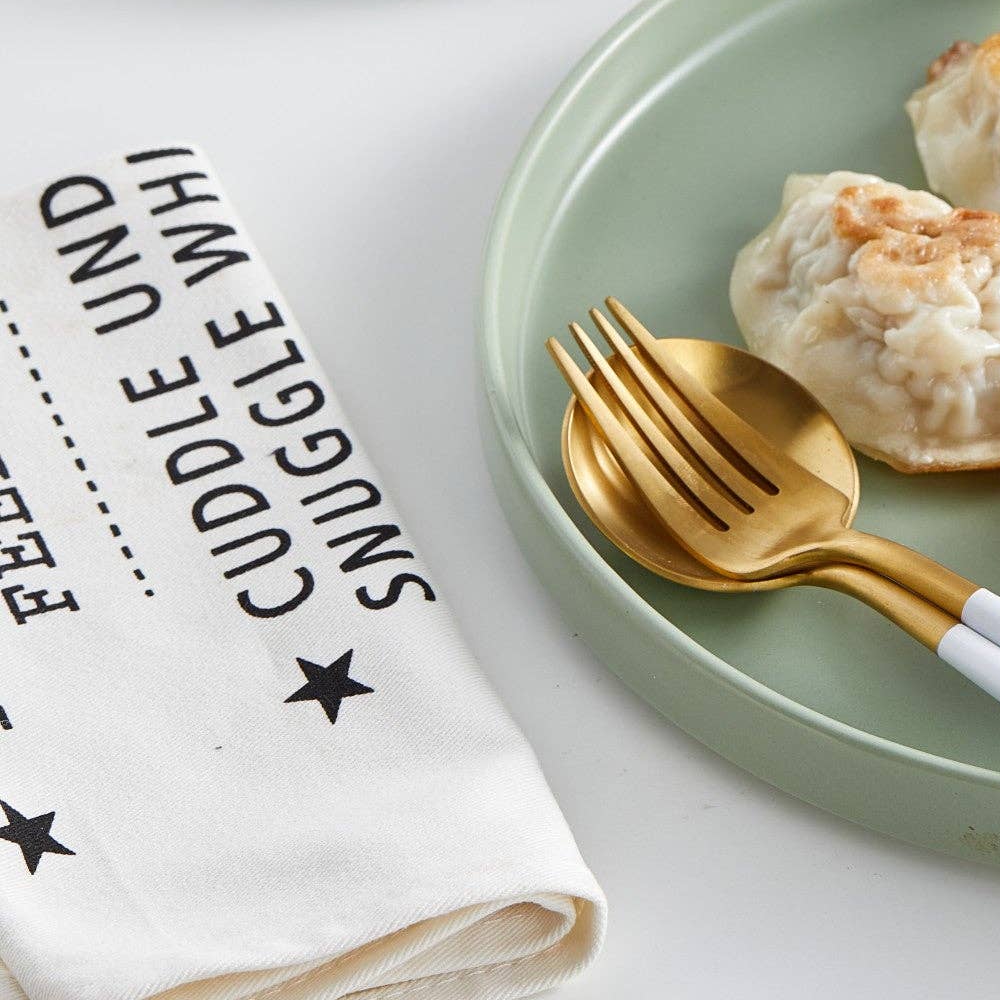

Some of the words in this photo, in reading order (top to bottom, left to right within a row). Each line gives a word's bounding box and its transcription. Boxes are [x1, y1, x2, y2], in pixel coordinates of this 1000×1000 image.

[39, 175, 161, 335] UND
[119, 355, 315, 619] CUDDLE
[204, 302, 437, 611] SNUGGLE
